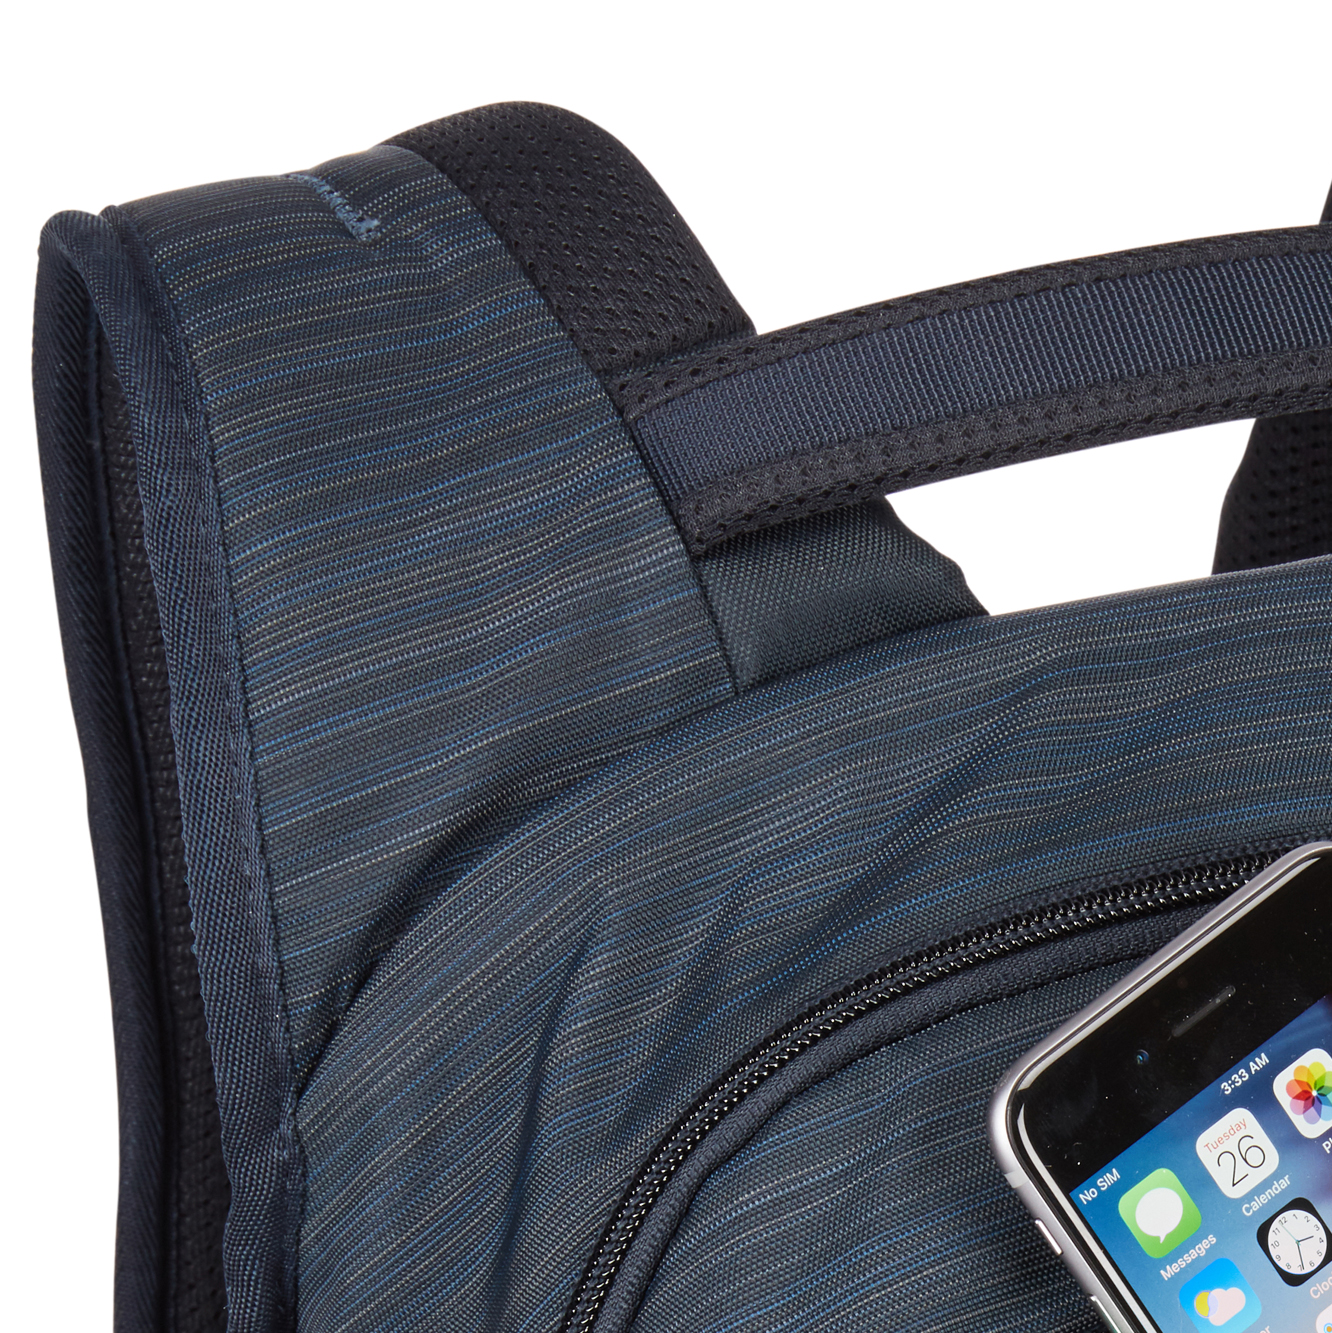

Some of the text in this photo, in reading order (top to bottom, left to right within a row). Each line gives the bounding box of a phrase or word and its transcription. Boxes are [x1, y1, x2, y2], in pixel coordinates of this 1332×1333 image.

[1220, 1052, 1270, 1095] 3:33 AM
[1204, 1118, 1248, 1153] Tuesday
[1217, 1135, 1266, 1187] 26
[1078, 1168, 1121, 1205] No SIM
[1242, 1173, 1291, 1217] Calendar
[1272, 1227, 1281, 1236] 11
[1278, 1216, 1288, 1226] 12
[1159, 1234, 1217, 1281] Messages
[1271, 1240, 1280, 1249] 10
